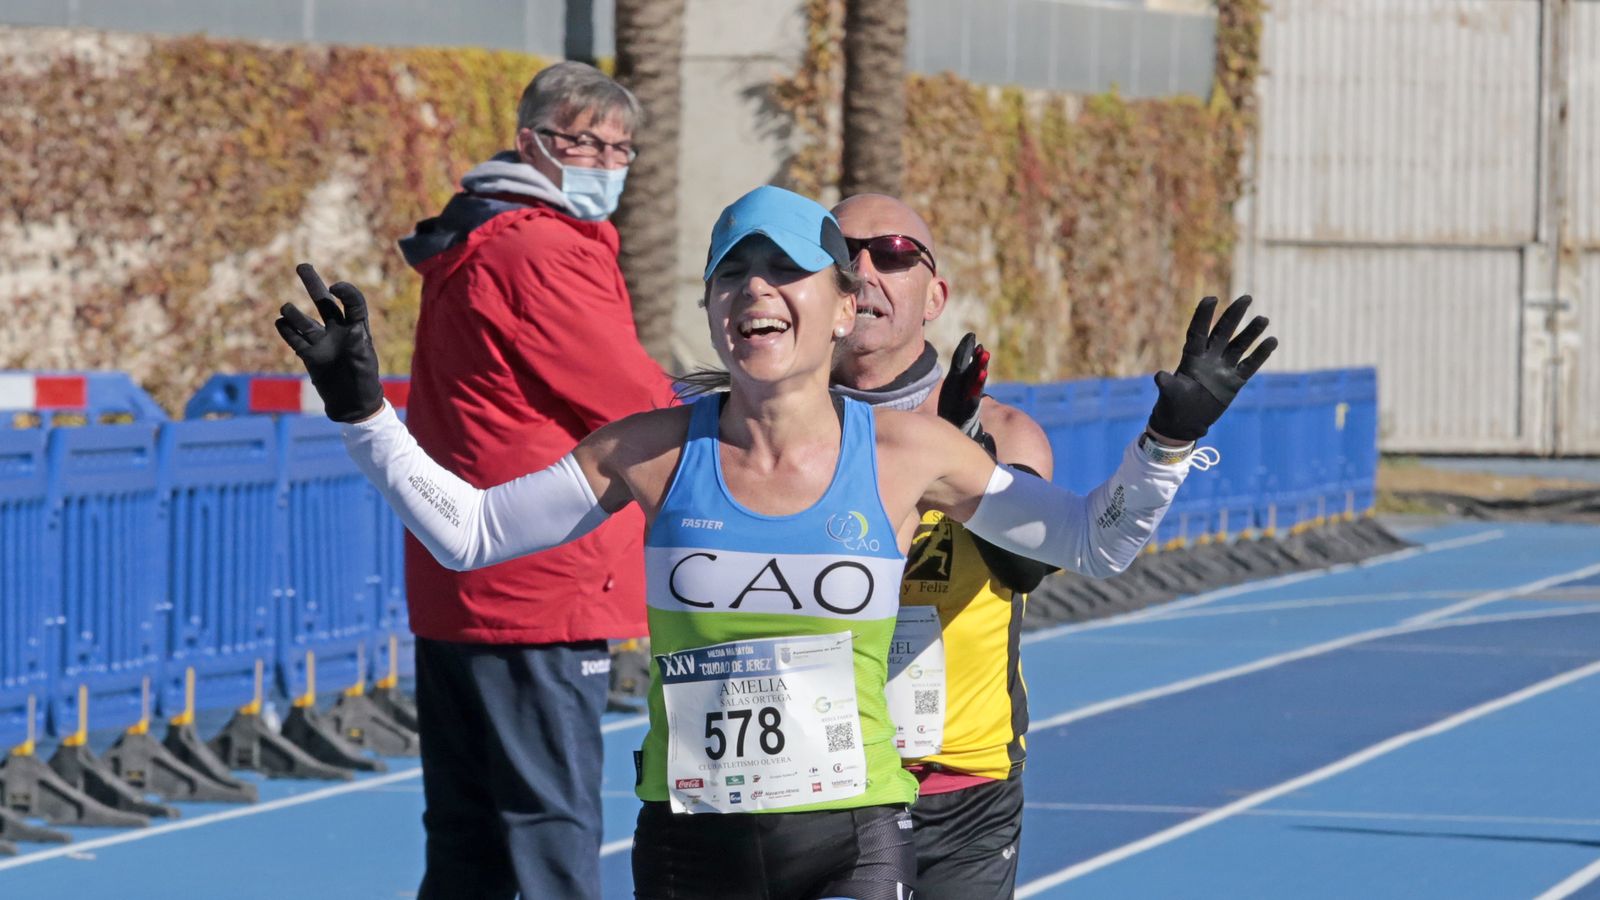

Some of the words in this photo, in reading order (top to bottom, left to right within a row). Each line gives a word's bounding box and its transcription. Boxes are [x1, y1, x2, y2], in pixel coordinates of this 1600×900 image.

[681, 518, 724, 531] FASTER
[843, 538, 880, 552] CAO
[669, 552, 875, 615] CAO
[904, 583, 911, 595] y
[920, 581, 949, 593] Feliz
[662, 654, 695, 677] XXV
[731, 660, 743, 673] DE
[720, 677, 788, 696] AMELIA
[720, 697, 750, 707] SALAS
[752, 694, 792, 704] ORTEGA
[705, 706, 785, 761] 578
[719, 759, 760, 769] ATLETISMO
[761, 756, 792, 766] OLVERA
